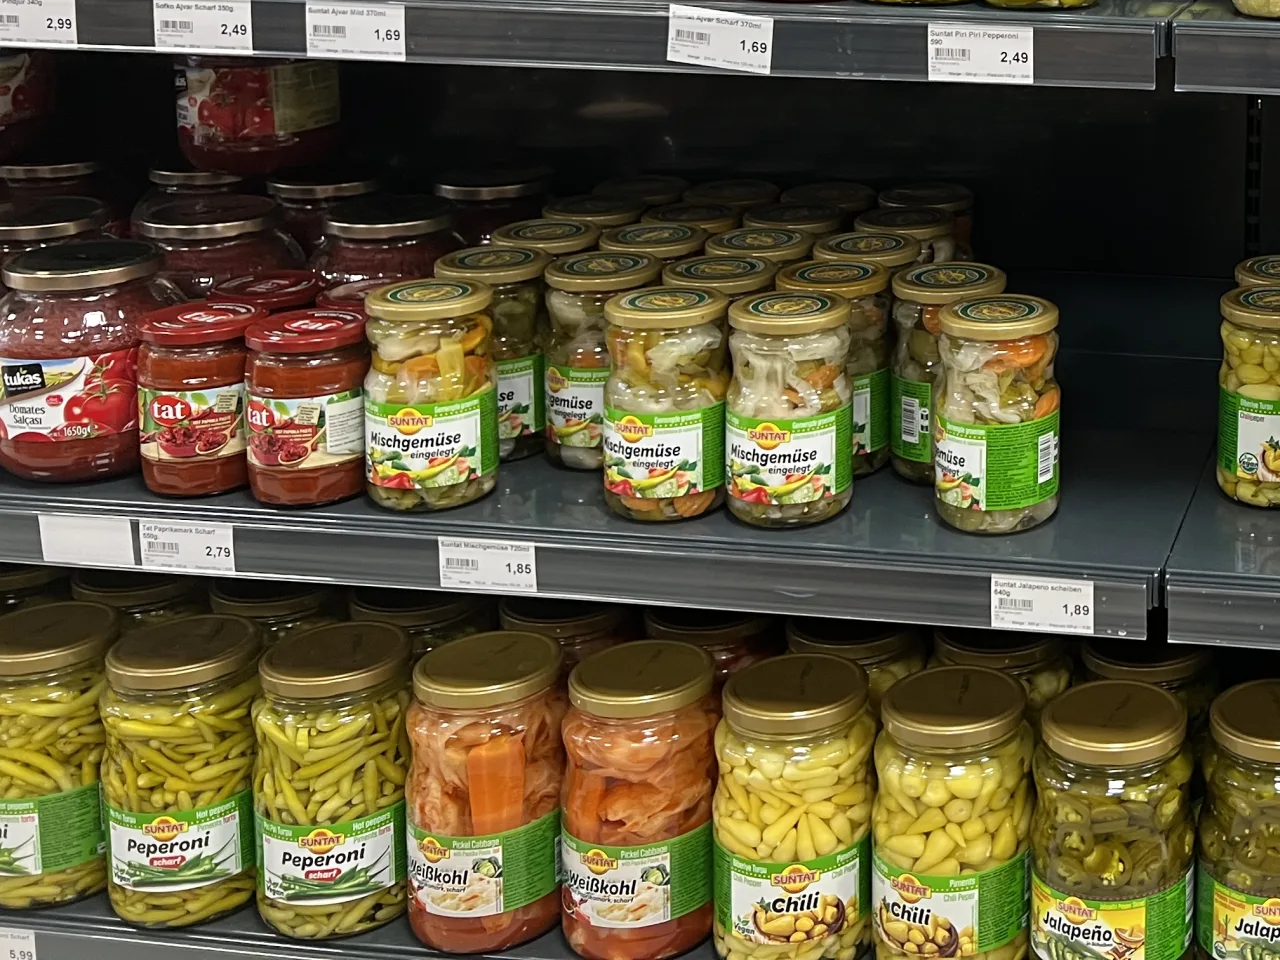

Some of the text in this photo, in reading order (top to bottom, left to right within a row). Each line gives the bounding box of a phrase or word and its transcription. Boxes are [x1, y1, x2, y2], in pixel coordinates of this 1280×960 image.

[176, 3, 193, 11] Ajvar
[195, 3, 216, 11] Scharf
[46, 18, 72, 31] 2,99
[696, 15, 714, 23] Ajvar
[716, 17, 739, 26] Scharf
[221, 24, 247, 37] 2,49
[374, 29, 400, 42] 1,69
[983, 32, 1019, 42] Pepperoni
[740, 40, 767, 54] 1,69
[1000, 51, 1028, 66] 2,49
[9, 403, 46, 416] Domates
[152, 402, 185, 420] tat
[63, 426, 88, 438] 1650g
[749, 430, 788, 442] SUNTAT
[370, 431, 462, 453] Mischgemüse
[410, 447, 456, 462] eingelegt
[730, 443, 818, 466] Mischgemüse
[768, 462, 812, 477] eingelegt
[205, 546, 230, 560] 2,79
[506, 563, 531, 577] 1,85
[1018, 582, 1049, 592] Jalapeno
[1062, 604, 1089, 617] 1,89
[143, 823, 186, 836] SUNTAT
[127, 830, 210, 858] Peperoni
[152, 855, 182, 867] scharf
[282, 843, 366, 871] Peperoni
[306, 869, 338, 881] scharf
[569, 866, 637, 896] Weißkohl
[774, 871, 818, 885] SUNTAT
[950, 877, 976, 888] Piments
[771, 890, 820, 914] Chili
[891, 900, 931, 926] Chili
[1042, 910, 1113, 942] Jalapeño
[10, 949, 33, 960] 5,99
